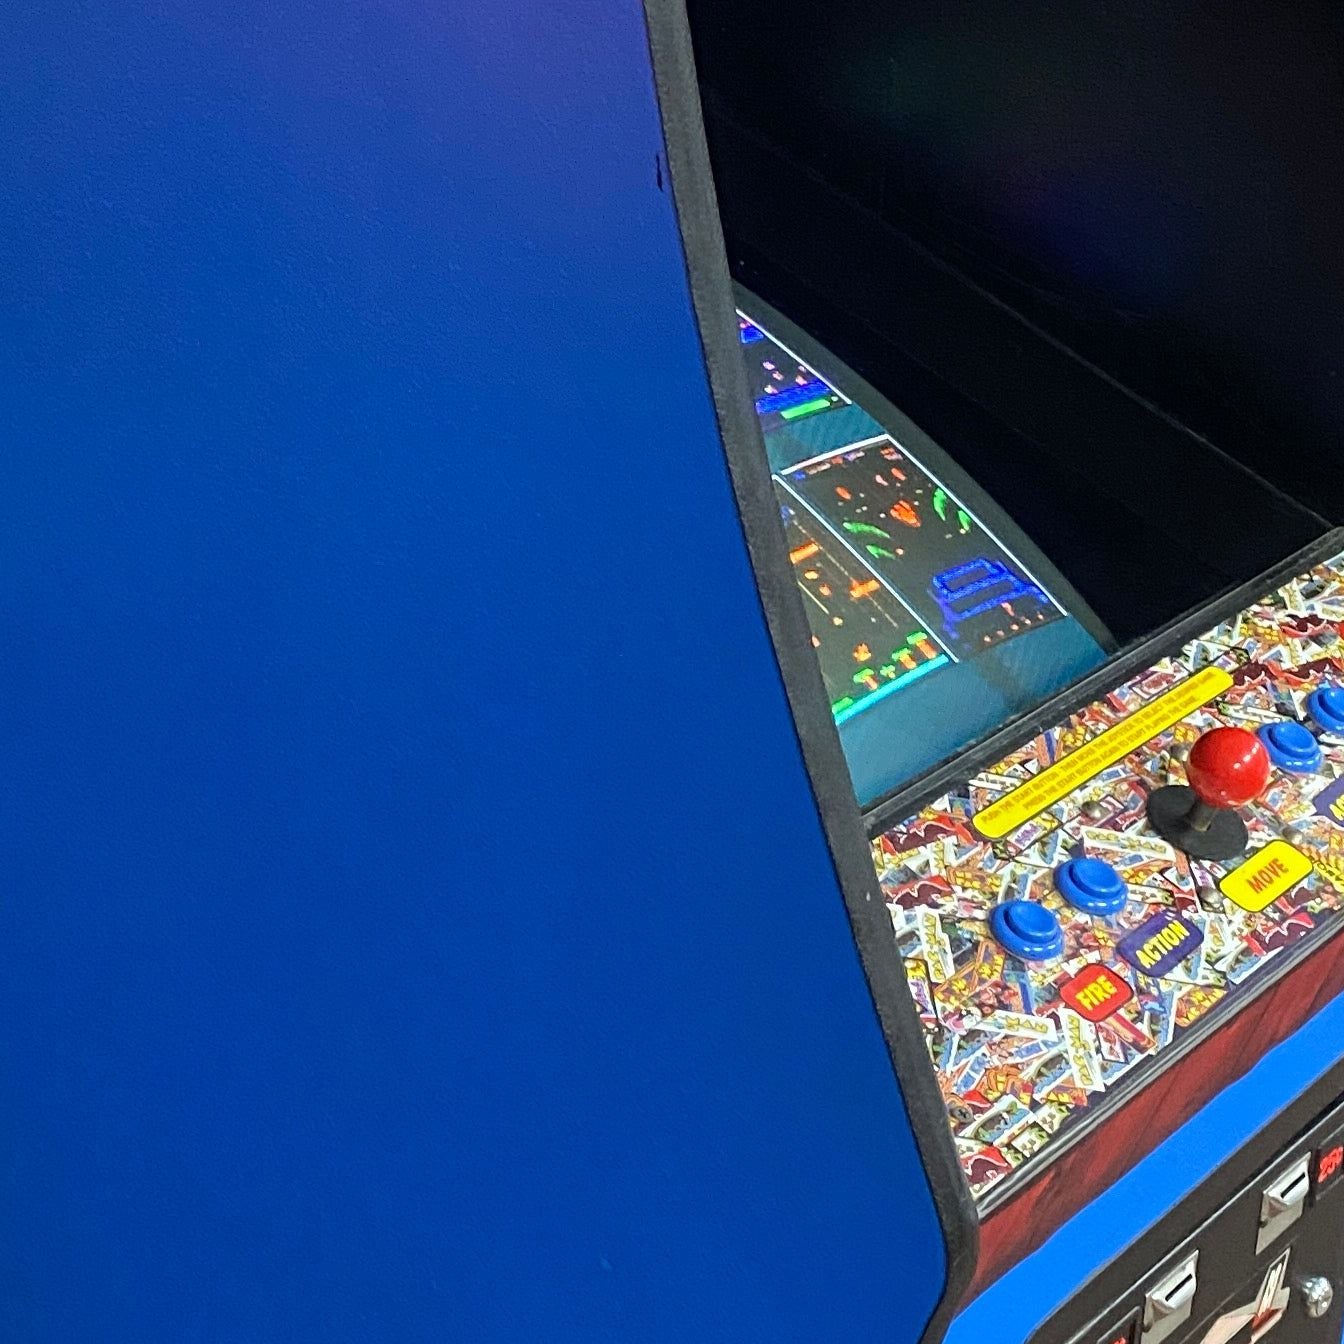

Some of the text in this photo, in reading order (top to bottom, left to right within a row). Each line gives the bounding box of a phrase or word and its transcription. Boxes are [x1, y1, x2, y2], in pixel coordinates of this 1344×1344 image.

[1245, 858, 1289, 895] MOVE
[1136, 920, 1190, 968] ACTION
[1075, 975, 1118, 1010] FIRE
